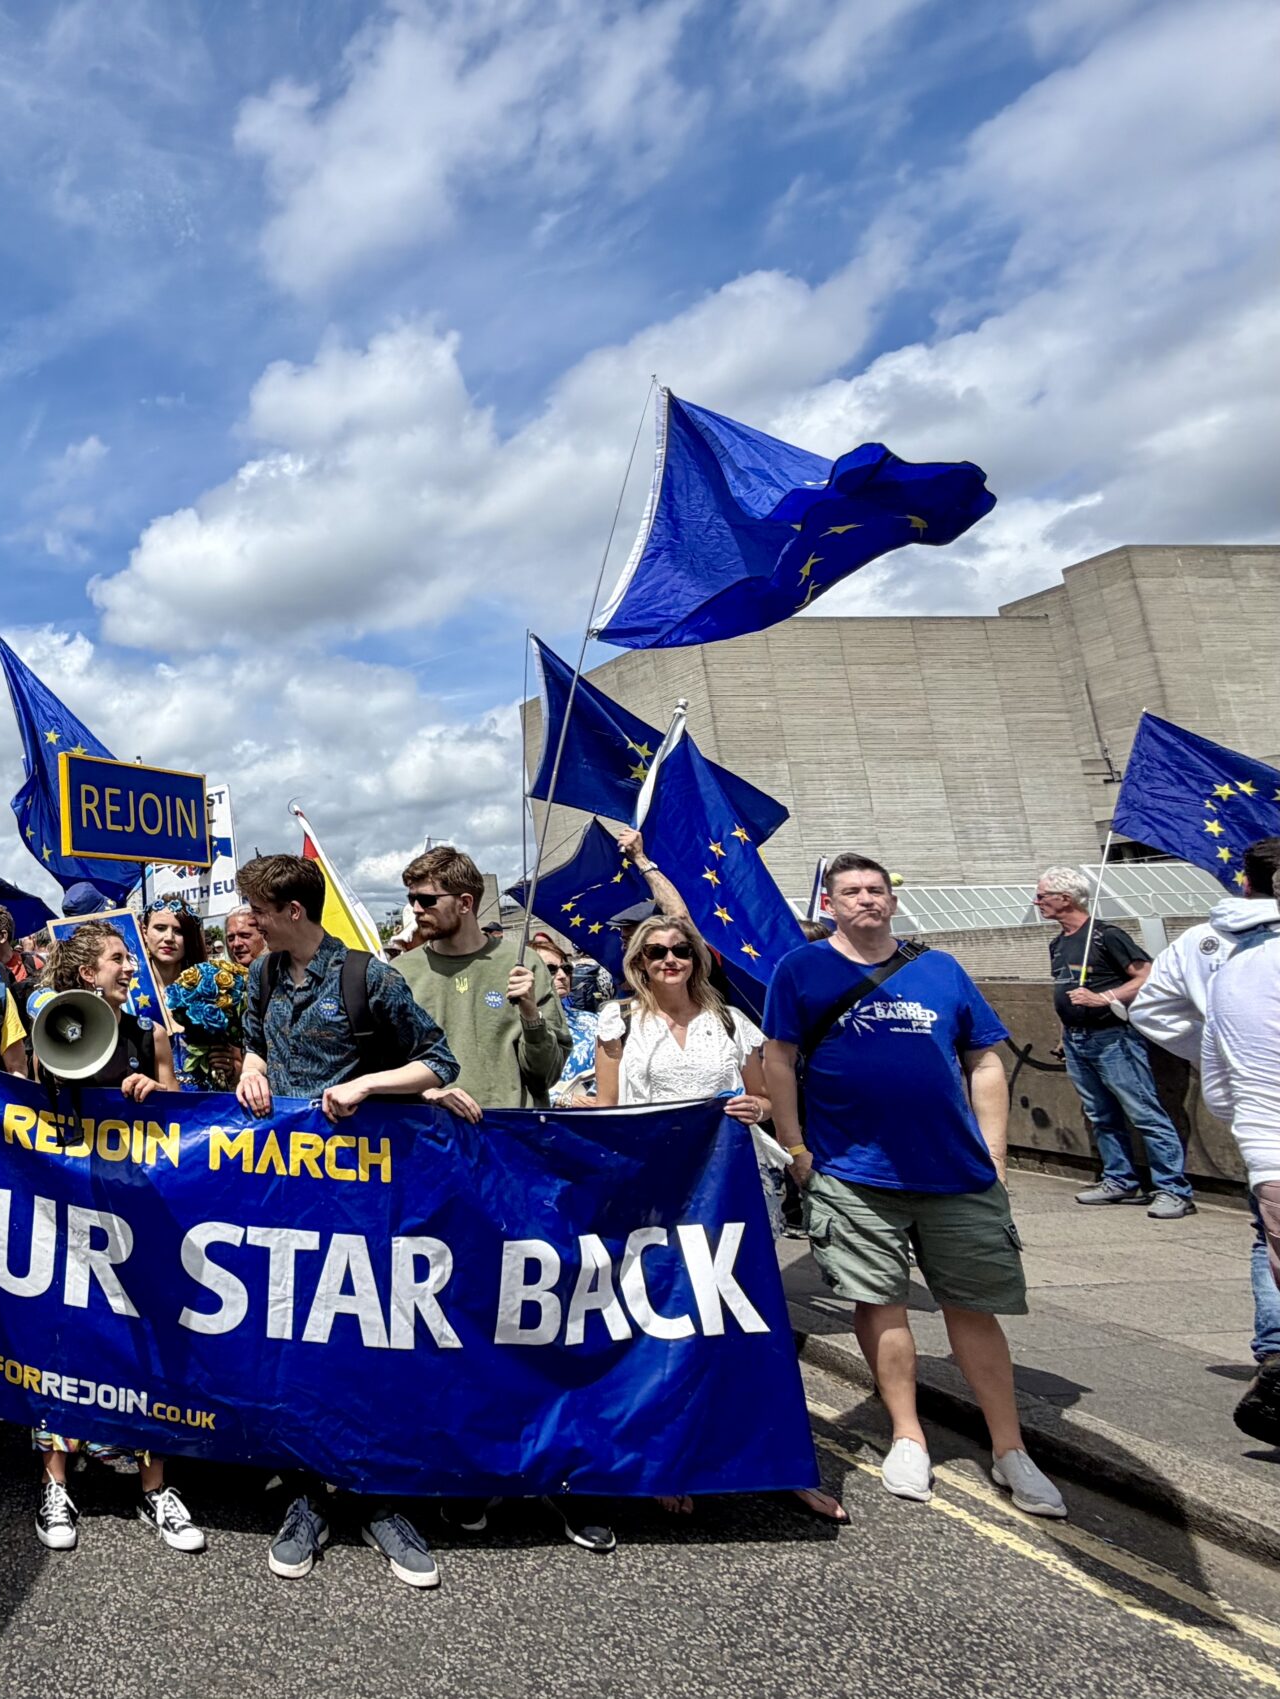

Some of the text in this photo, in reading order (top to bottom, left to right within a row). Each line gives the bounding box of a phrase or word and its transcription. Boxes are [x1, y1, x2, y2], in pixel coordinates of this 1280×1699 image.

[206, 791, 225, 807] ST
[80, 784, 197, 839] REJOIN
[172, 885, 210, 900] WITH
[213, 879, 234, 895] EU
[873, 1001, 922, 1010] NO HOLDS
[875, 1009, 938, 1021] BARRED
[4, 1103, 180, 1168] REJOIN
[209, 1125, 392, 1183] MARCH
[177, 1221, 463, 1350] STAR
[494, 1222, 771, 1346] BACK
